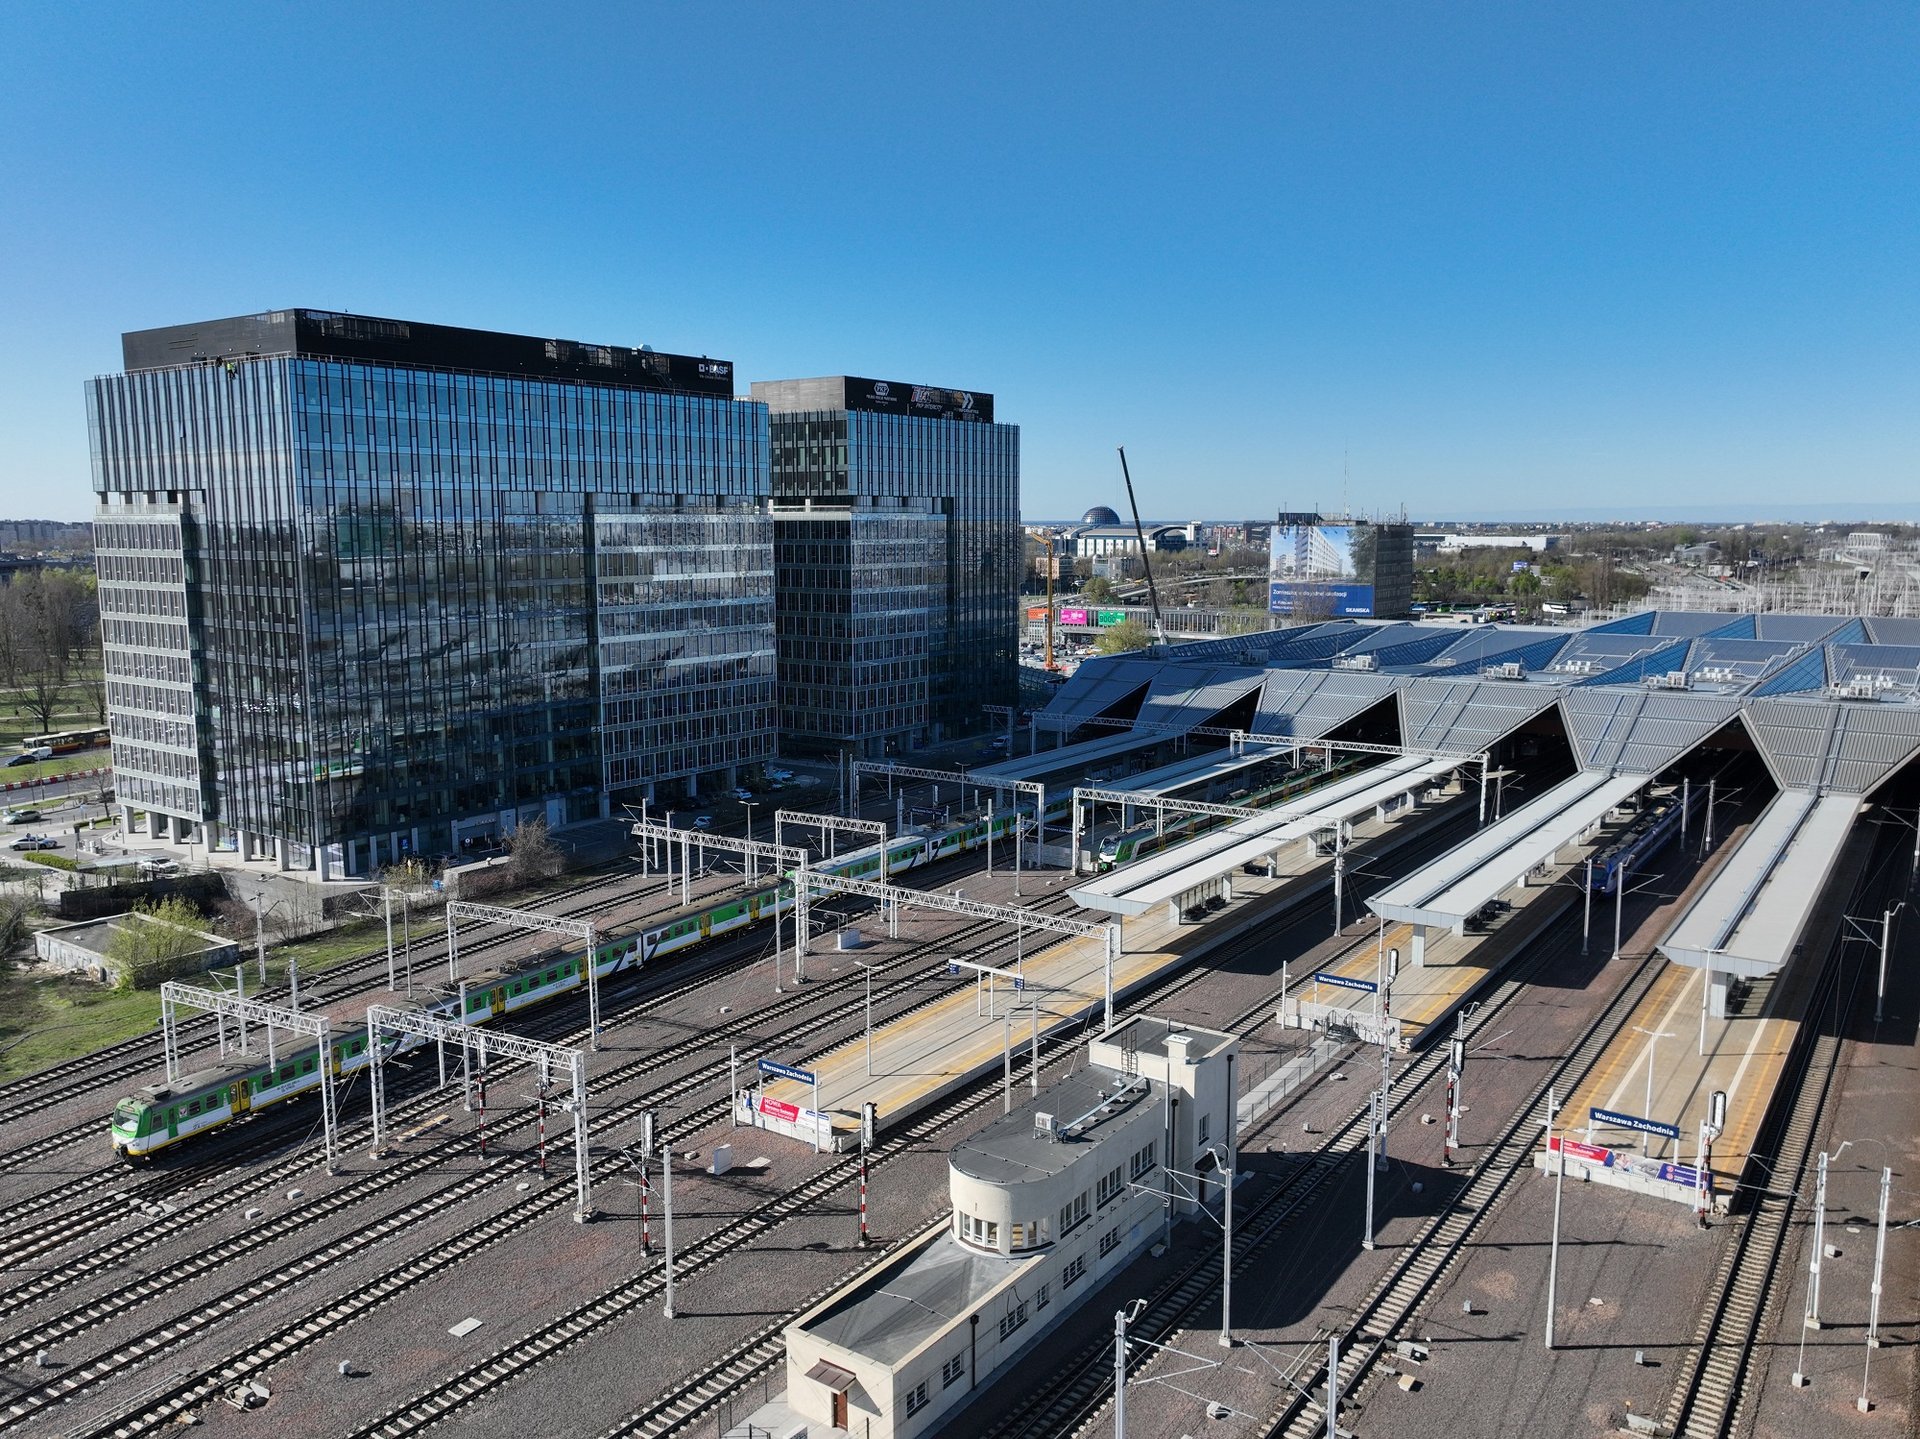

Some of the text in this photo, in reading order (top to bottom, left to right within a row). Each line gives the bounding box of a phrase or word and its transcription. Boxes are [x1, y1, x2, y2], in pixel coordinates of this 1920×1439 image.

[710, 364, 728, 375] BASF
[1318, 975, 1373, 990] Warszawa Zachodnia
[761, 1062, 812, 1082] Warszawa Zachodnia
[1594, 1112, 1674, 1136] Warszawa Zachodnia
